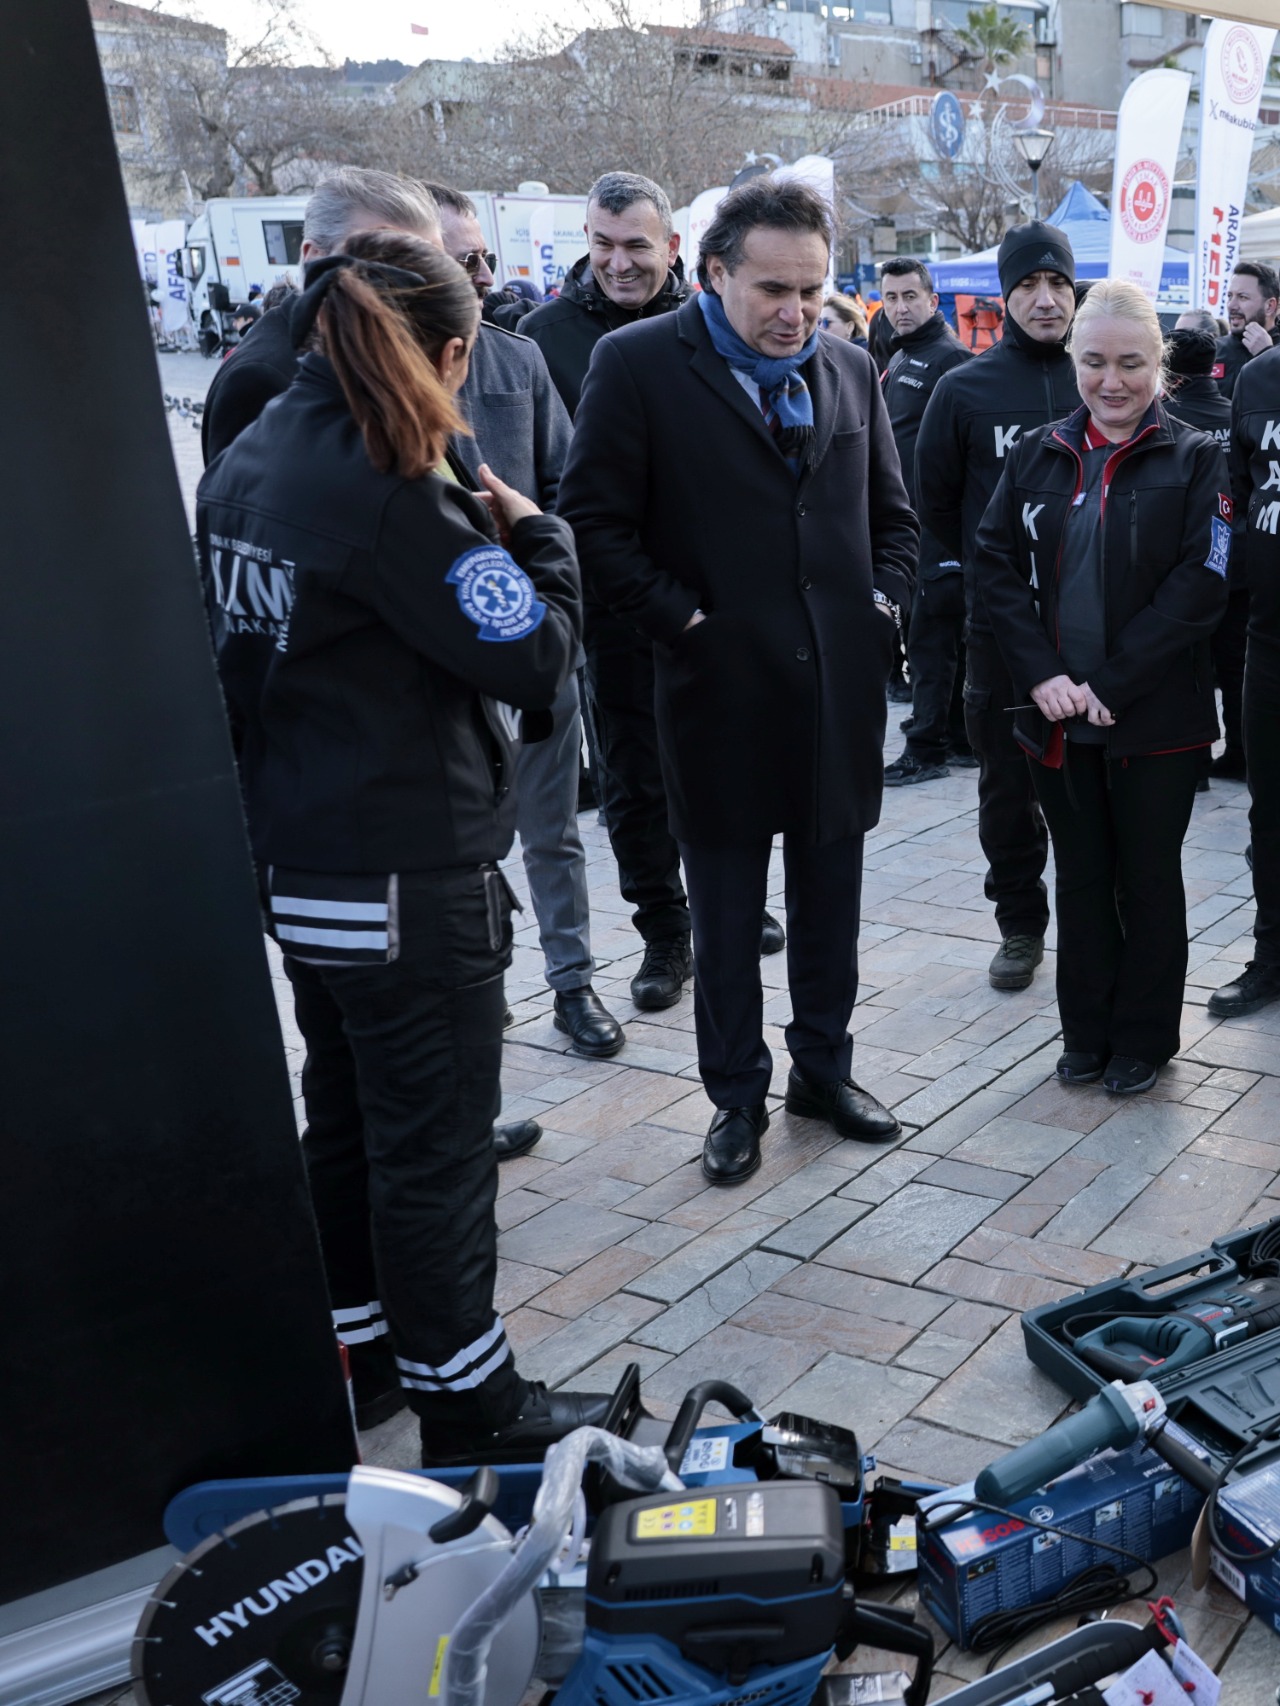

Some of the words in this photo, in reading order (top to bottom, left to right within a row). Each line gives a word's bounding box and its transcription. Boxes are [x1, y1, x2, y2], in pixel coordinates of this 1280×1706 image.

[1227, 204, 1240, 273] ARAMA
[455, 550, 504, 579] EMERGENCY
[461, 568, 477, 600] KONAK
[500, 616, 534, 637] RESCUE
[955, 1517, 1026, 1554] BOSCH
[194, 1536, 366, 1648] HYUNDAI
